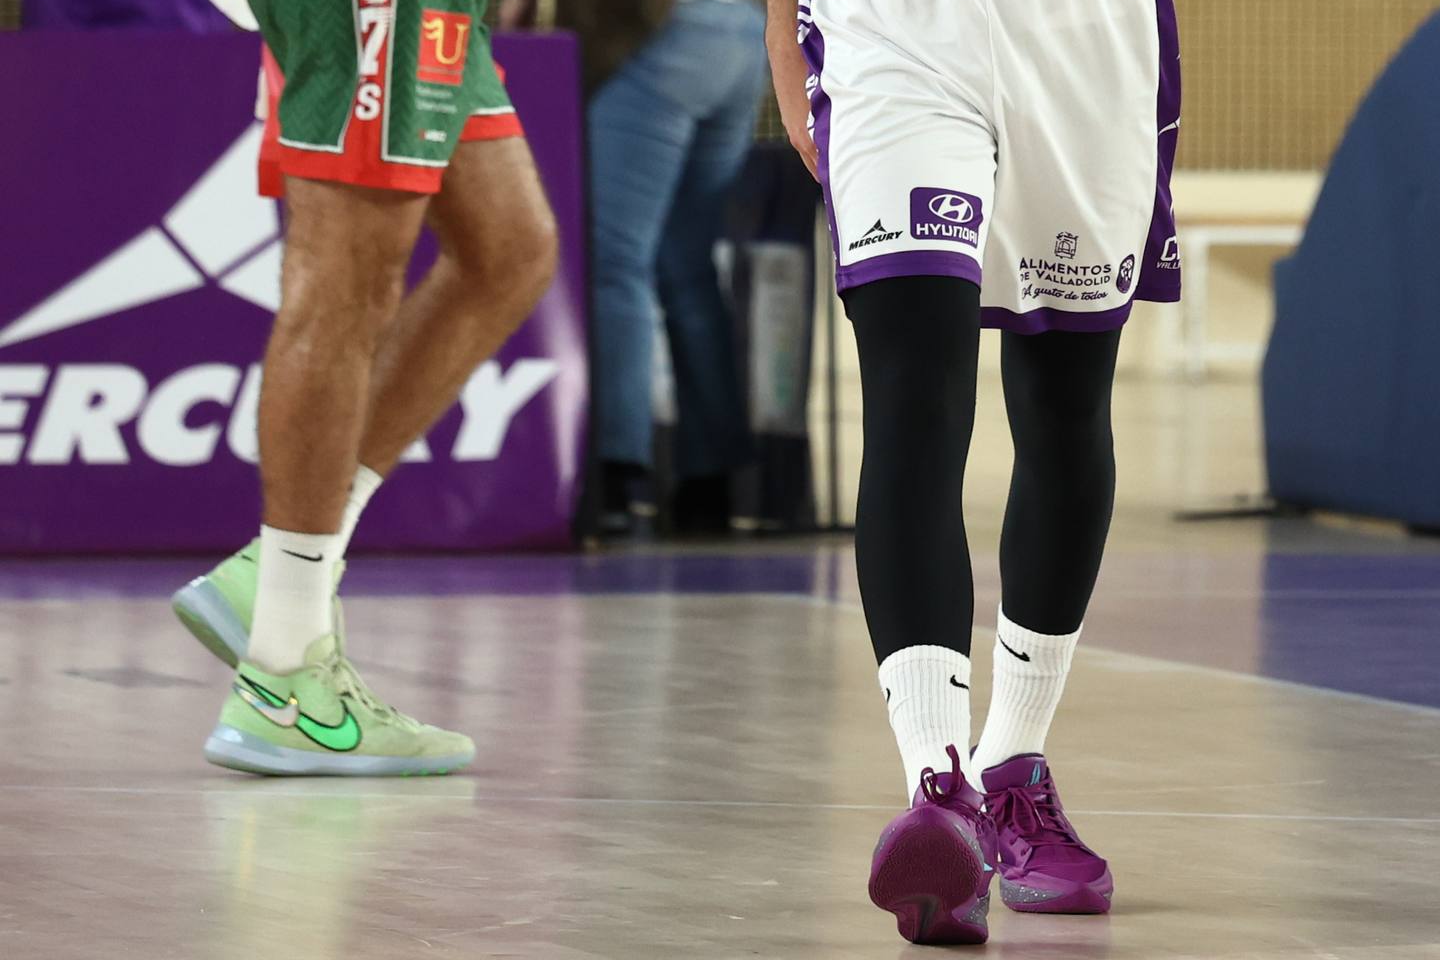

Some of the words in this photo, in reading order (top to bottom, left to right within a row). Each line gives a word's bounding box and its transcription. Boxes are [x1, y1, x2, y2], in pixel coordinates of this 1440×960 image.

[849, 230, 904, 251] MERCURY
[916, 223, 978, 245] HYUNDAI
[1020, 257, 1112, 276] ALIMENTOS
[1036, 270, 1111, 287] VALLADOLID
[1032, 287, 1066, 299] gusto
[1064, 291, 1079, 300] de
[1081, 290, 1108, 301] todos
